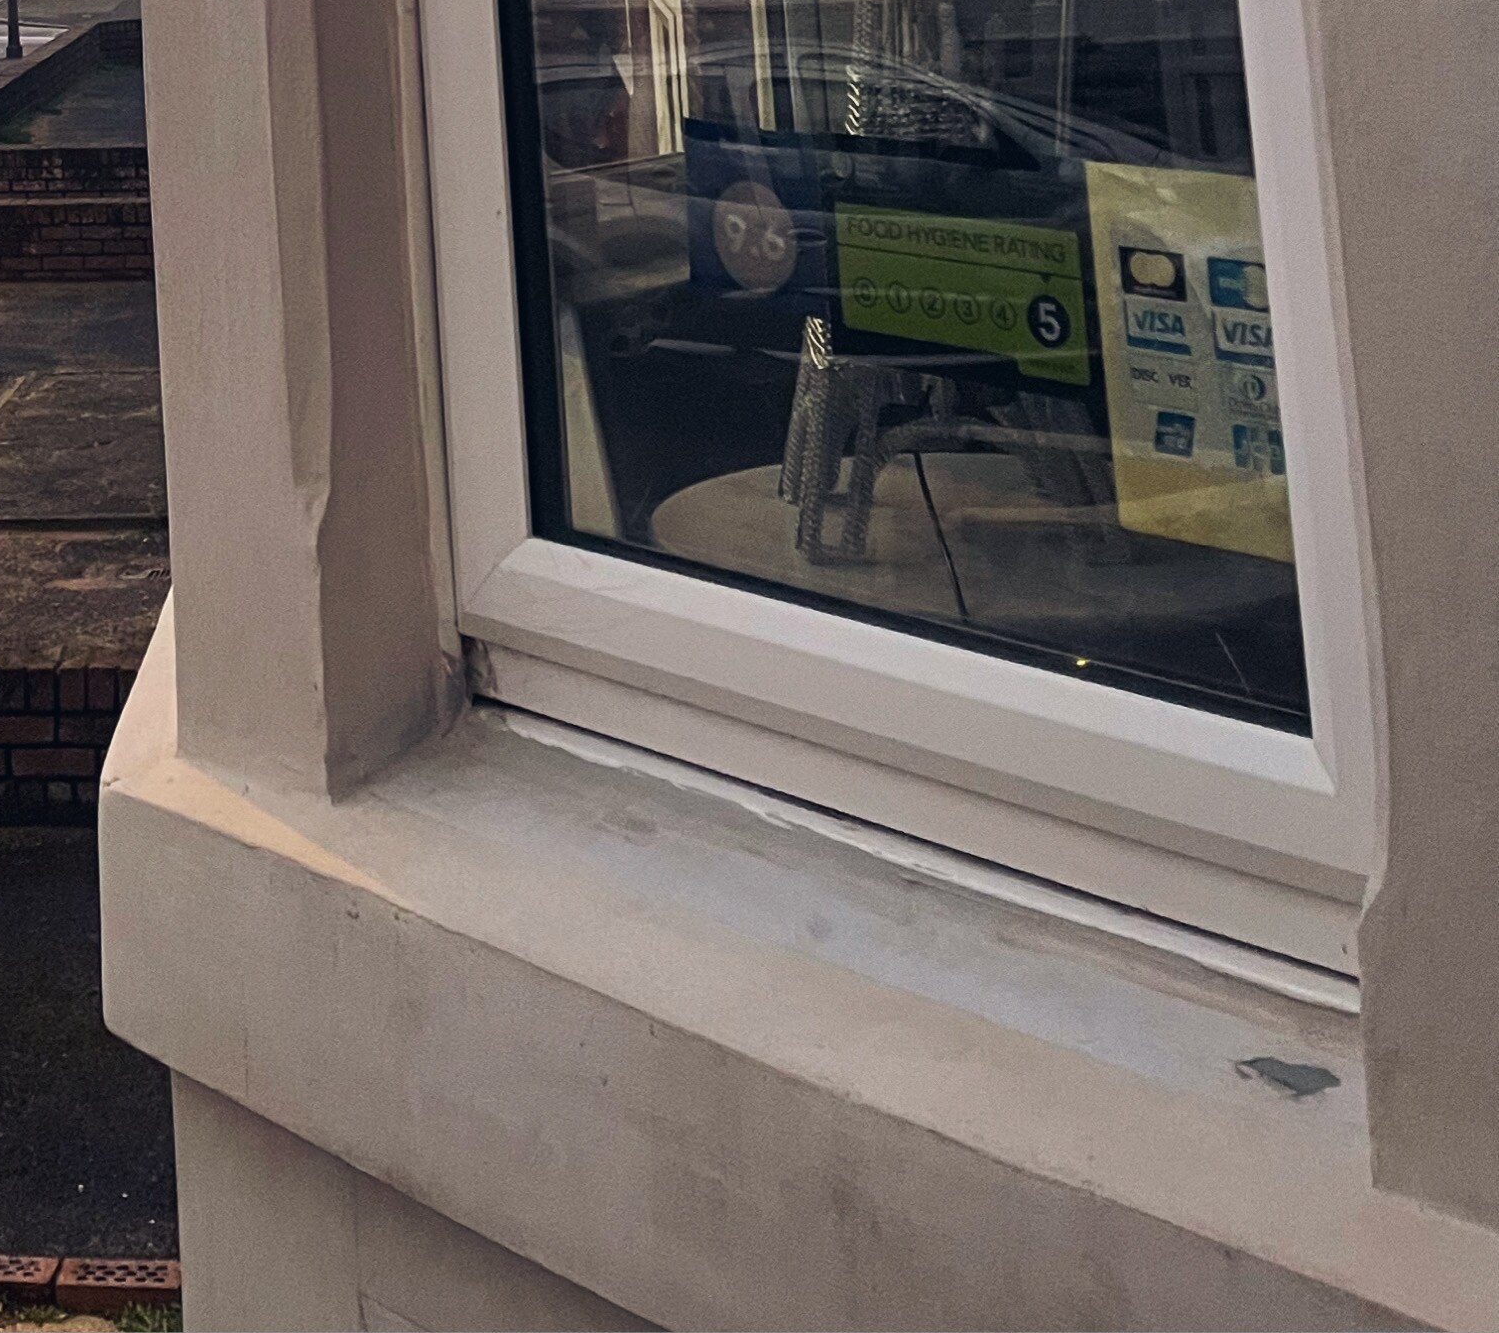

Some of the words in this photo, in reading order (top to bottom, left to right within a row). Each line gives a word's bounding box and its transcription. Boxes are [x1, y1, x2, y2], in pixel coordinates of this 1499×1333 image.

[846, 217, 901, 240] FOOD
[908, 224, 990, 252] HYGIENE
[994, 236, 1066, 263] RATING
[1038, 302, 1062, 342] 5
[1134, 310, 1186, 337] VISA
